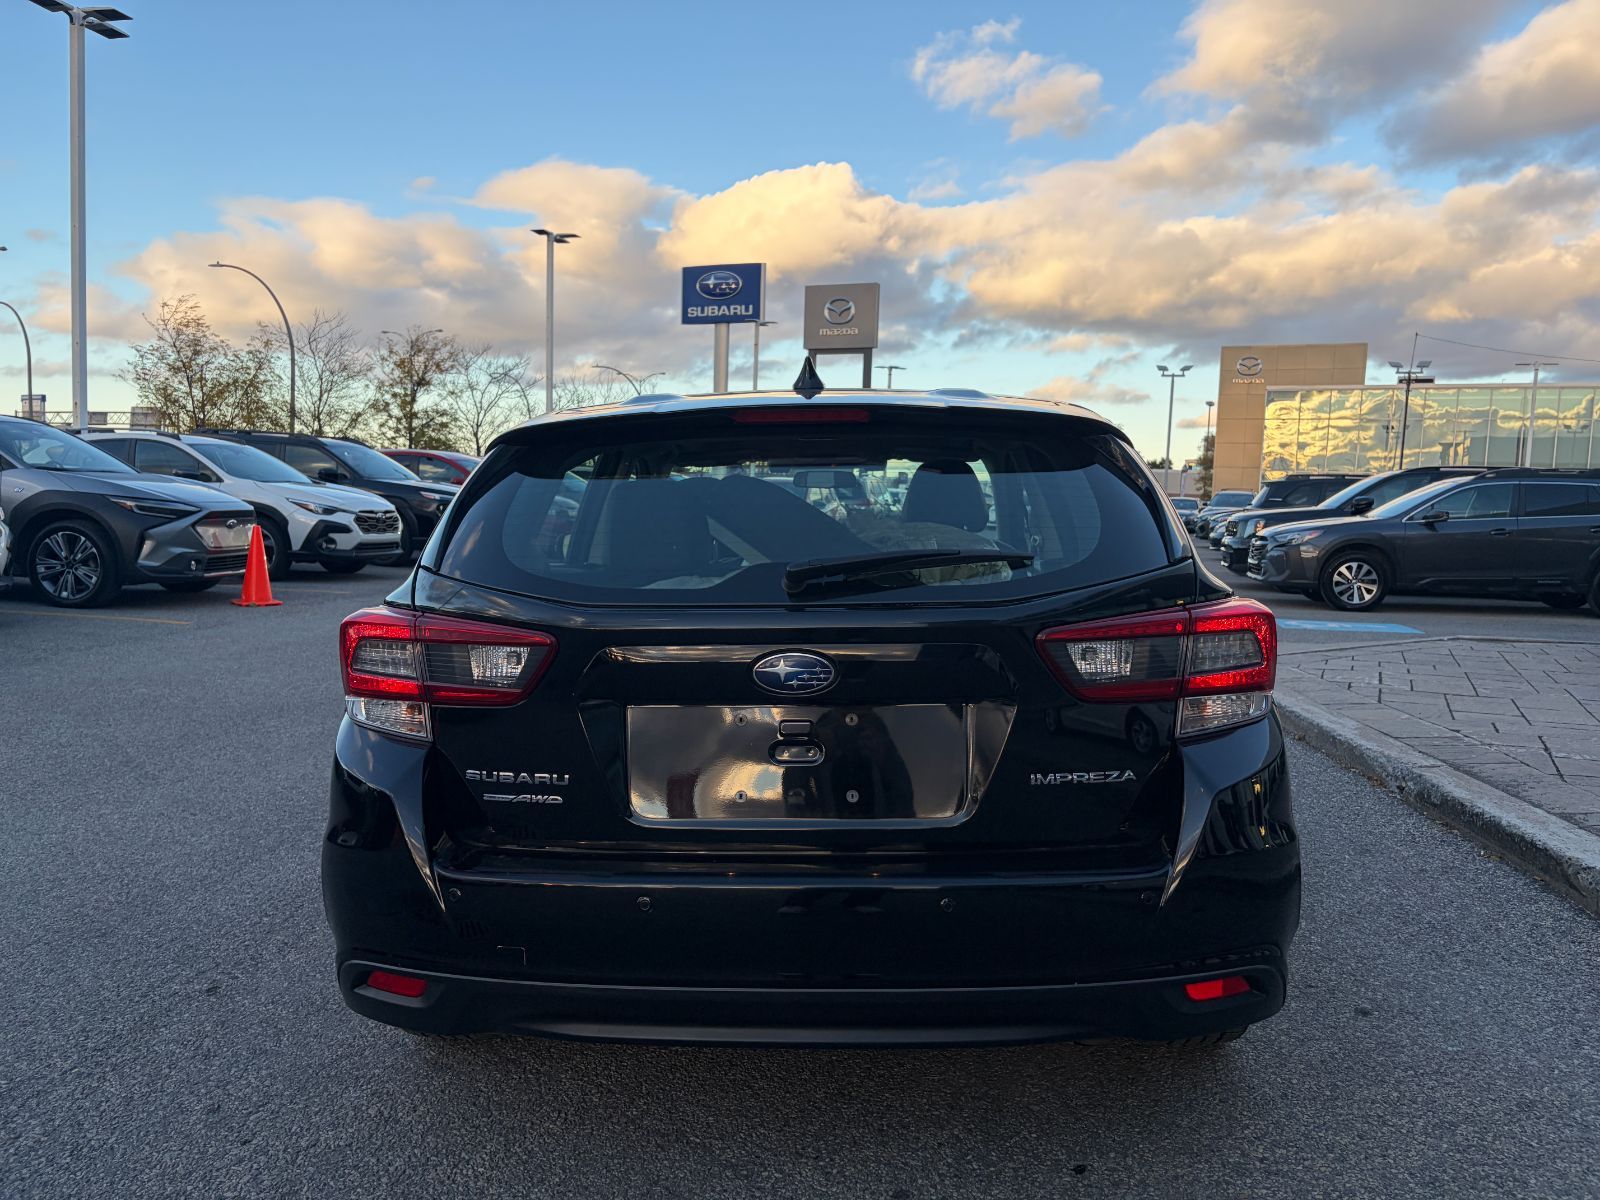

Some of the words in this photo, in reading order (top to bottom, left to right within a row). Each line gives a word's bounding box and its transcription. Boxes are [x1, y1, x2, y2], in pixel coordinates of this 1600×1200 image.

[687, 304, 753, 317] SUBARU
[819, 327, 859, 336] mazda
[465, 769, 570, 786] SUBARU
[1030, 769, 1137, 785] IMPREZA
